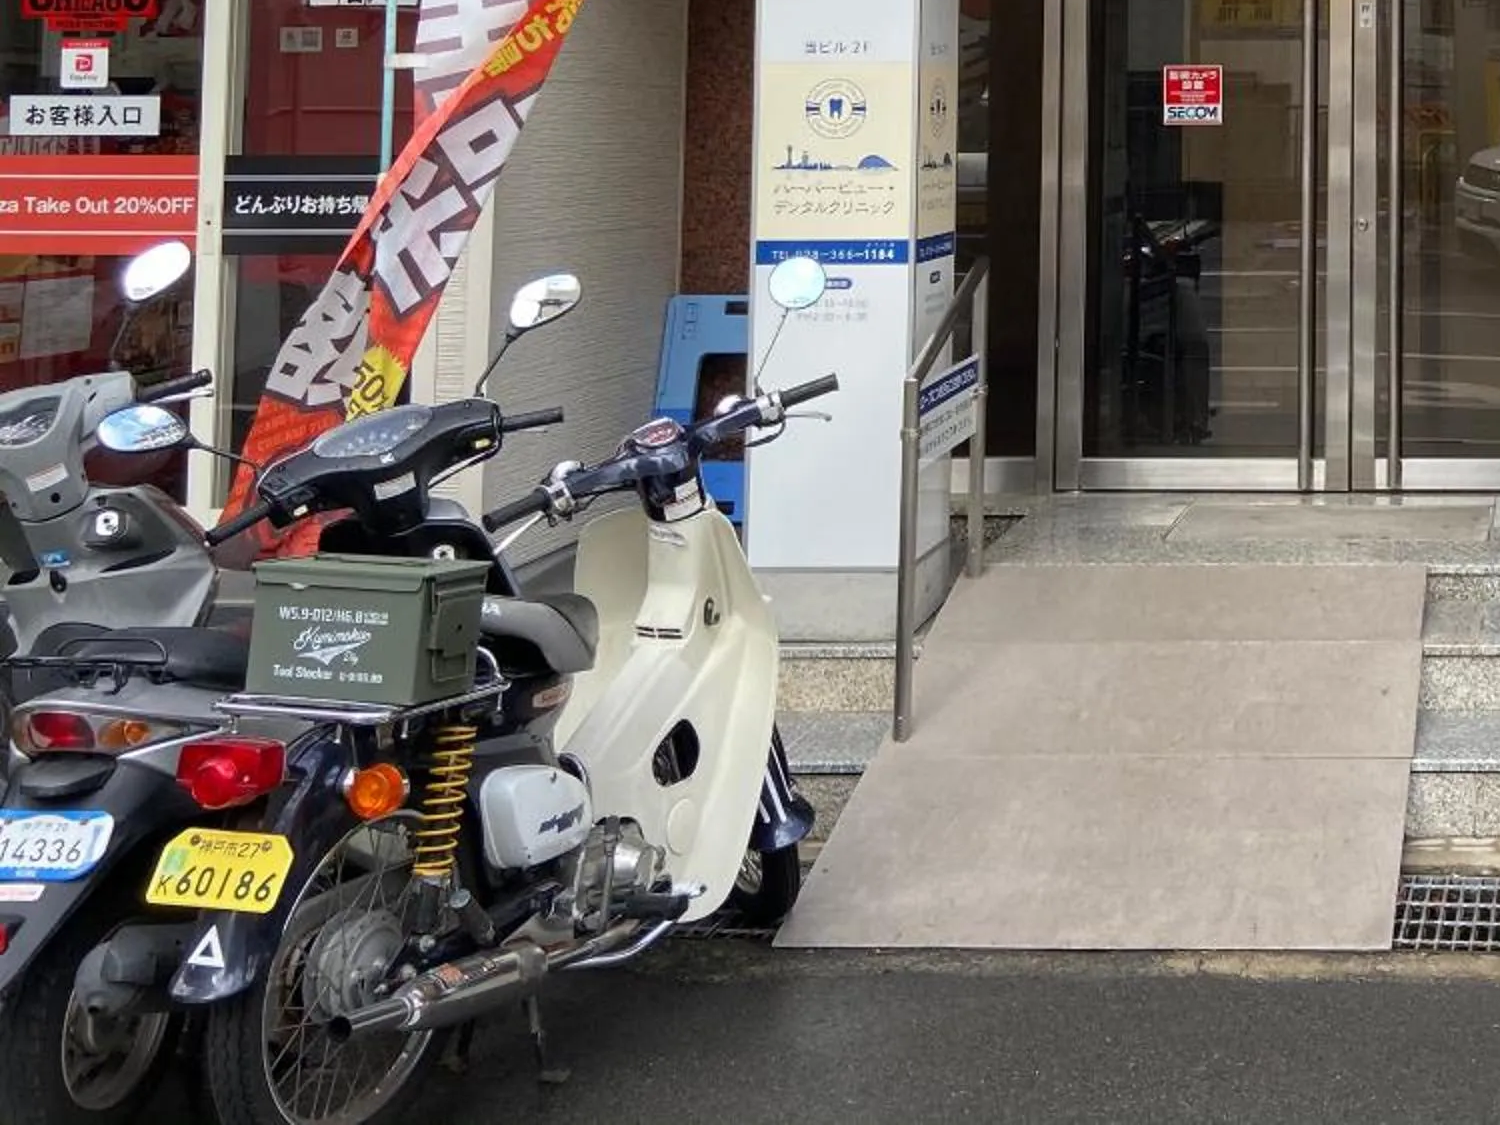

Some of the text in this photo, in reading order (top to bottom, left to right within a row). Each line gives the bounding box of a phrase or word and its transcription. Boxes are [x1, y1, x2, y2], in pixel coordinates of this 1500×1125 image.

[26, 105, 142, 126] お客様入口
[1167, 106, 1218, 120] SECOM
[24, 196, 71, 214] Take
[75, 196, 109, 214] Out
[113, 196, 196, 215] 20%OFF
[774, 200, 895, 216] デンタルクリニック
[176, 866, 277, 902] 60186
